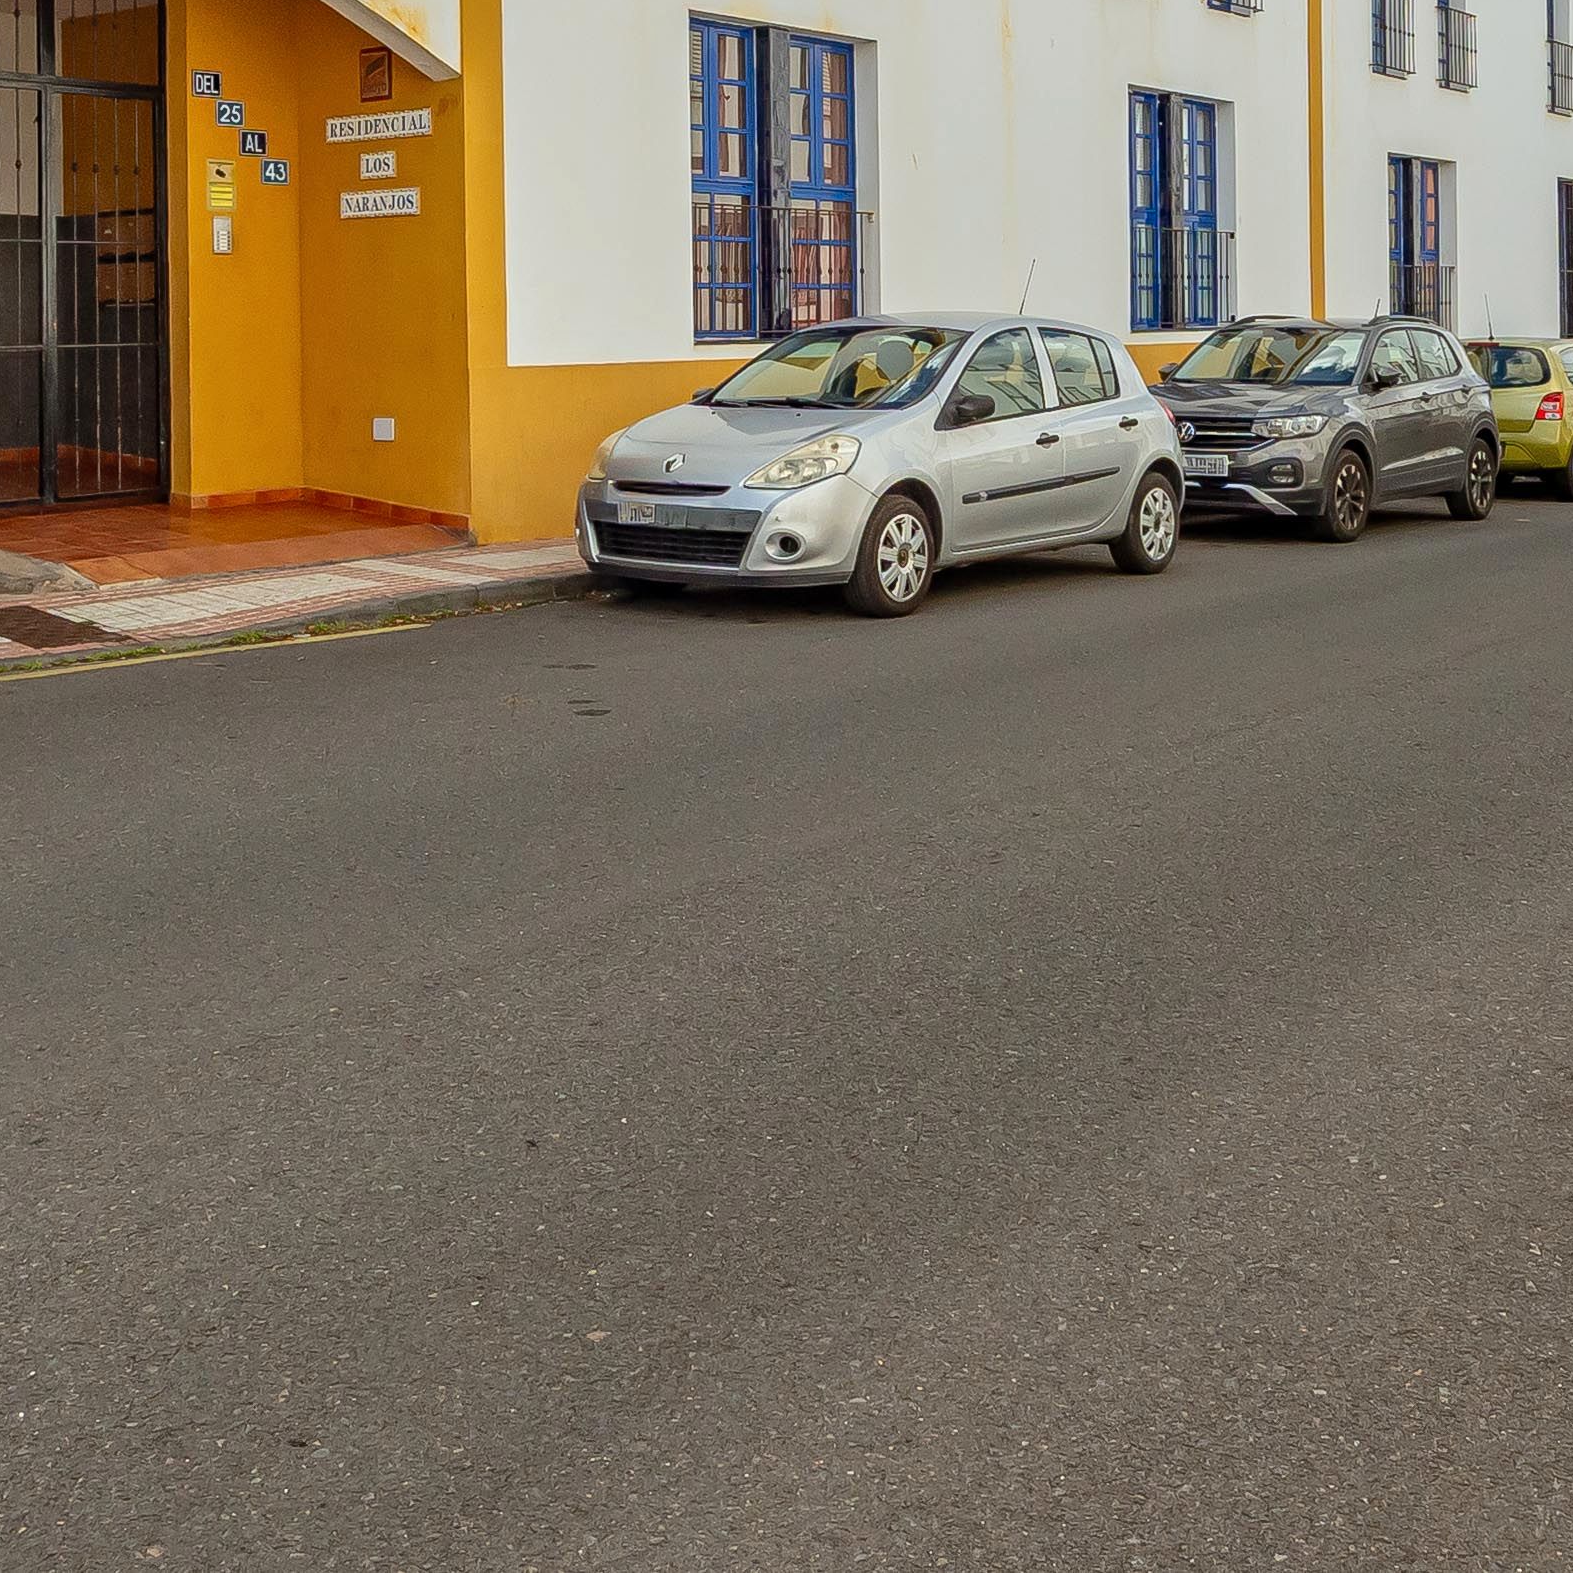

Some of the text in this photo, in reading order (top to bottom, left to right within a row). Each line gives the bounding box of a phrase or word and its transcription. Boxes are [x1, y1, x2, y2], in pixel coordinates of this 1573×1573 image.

[195, 74, 219, 94] DEL
[219, 104, 241, 123] 25
[329, 113, 427, 138] RESIDENCIAL
[245, 133, 263, 153] AL
[265, 162, 286, 181] 43
[365, 157, 391, 174] LOS
[344, 194, 415, 214] NARANJOS
